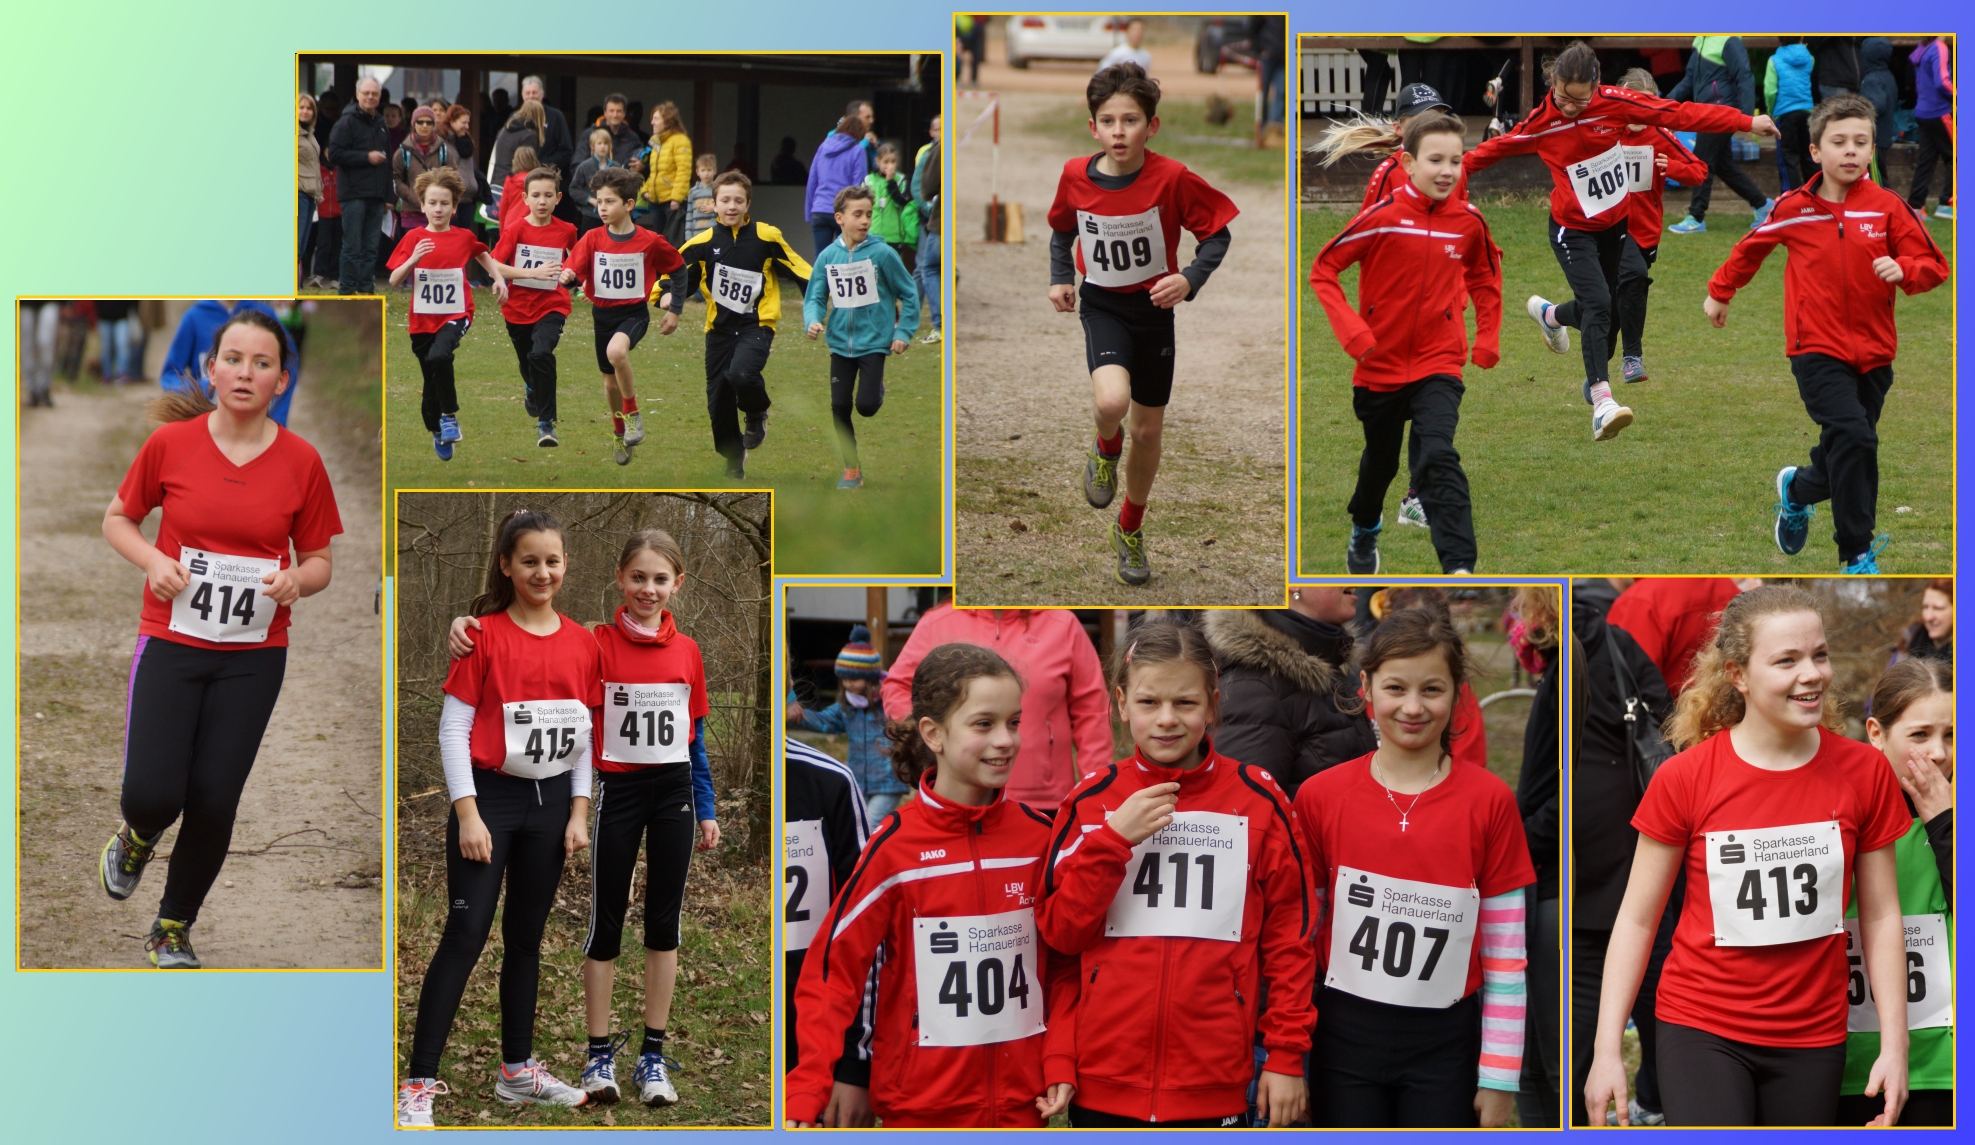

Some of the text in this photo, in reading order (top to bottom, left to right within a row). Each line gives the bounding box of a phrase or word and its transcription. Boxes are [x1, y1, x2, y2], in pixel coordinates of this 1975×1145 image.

[1590, 152, 1617, 168] Sparkasse
[1592, 155, 1622, 174] Hanauerland
[1588, 163, 1625, 200] 406
[1102, 220, 1144, 231] Sparkasse
[1103, 224, 1153, 237] Hanauerland
[1093, 236, 1152, 272] 409
[601, 268, 636, 289] 409
[835, 275, 868, 298] 578
[421, 283, 456, 304] 402
[719, 278, 753, 305] 589
[213, 571, 264, 583] Hanauerlan
[214, 561, 260, 574] Sparkasse
[190, 581, 255, 626] 414
[634, 690, 674, 700] Sparkasse
[634, 699, 681, 707] Hanauerland
[537, 707, 578, 716] Sparkasse
[538, 715, 585, 724] Hanauerland
[620, 710, 675, 747] 416
[525, 727, 576, 764] 415
[1161, 821, 1220, 835] parkasse
[1152, 833, 1233, 850] Hanauerland
[1753, 835, 1816, 850] Sparkasse
[920, 849, 946, 861] JAKO
[1754, 844, 1829, 862] Hanauerland
[1004, 882, 1024, 895] LBV
[1133, 852, 1215, 910] 411
[1383, 887, 1452, 909] Sparkasse
[1736, 863, 1818, 921] 413
[1381, 900, 1464, 923] Hanauerland
[968, 922, 1023, 942] Sparkasse
[969, 934, 1030, 953] Hanauerland
[1349, 915, 1449, 981] 407
[939, 953, 1029, 1017] 404
[1221, 1115, 1238, 1127] JAKO
